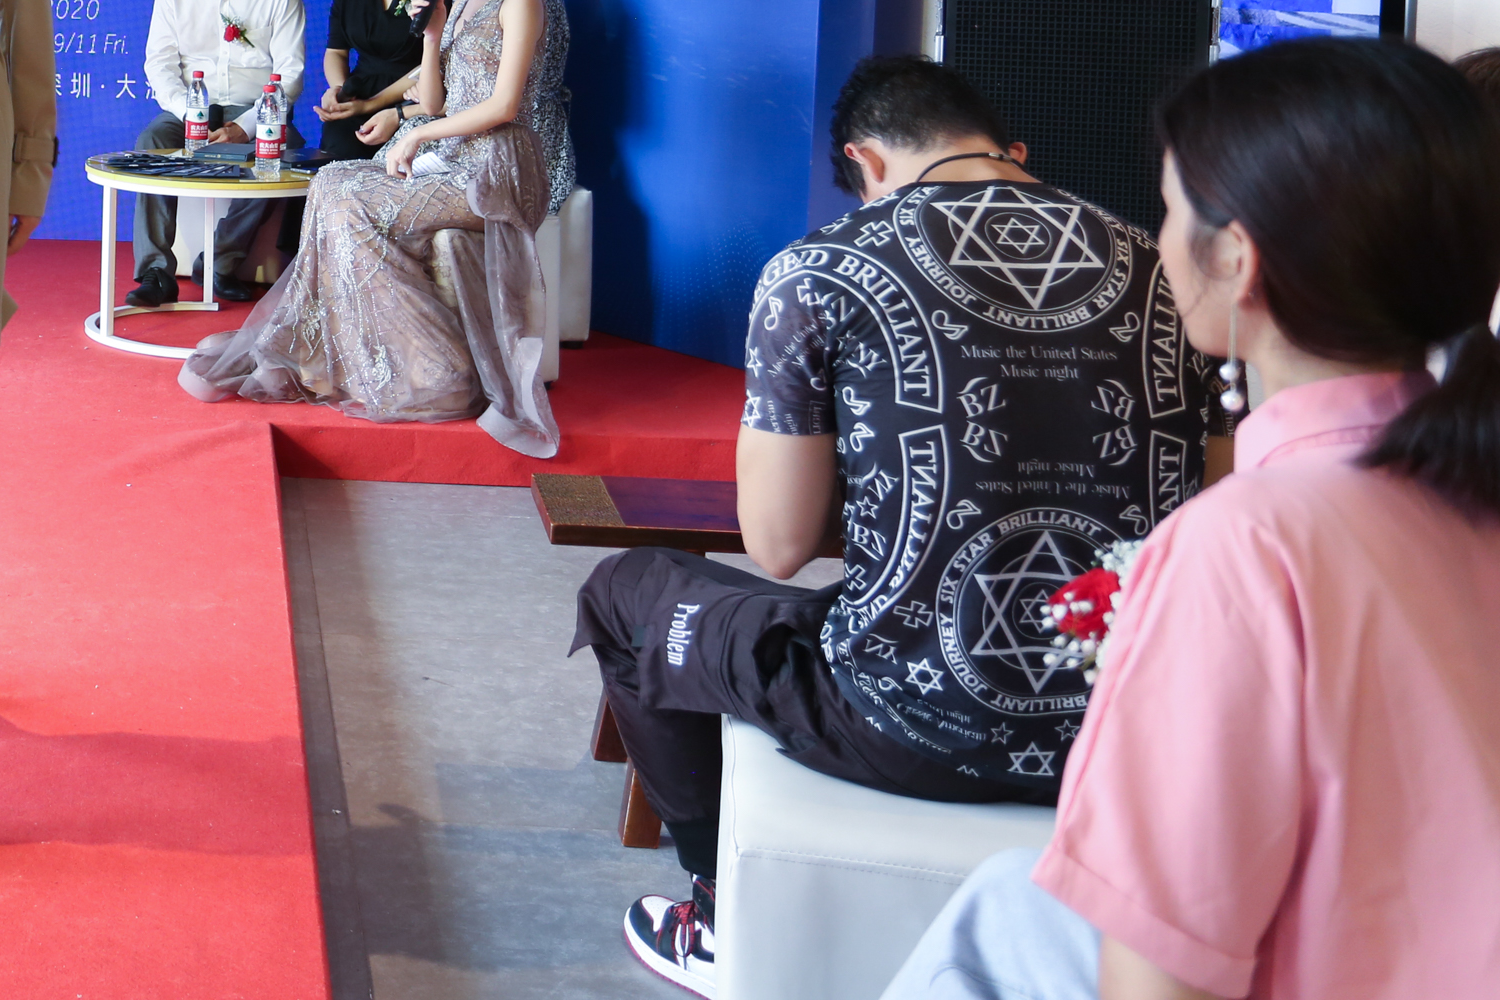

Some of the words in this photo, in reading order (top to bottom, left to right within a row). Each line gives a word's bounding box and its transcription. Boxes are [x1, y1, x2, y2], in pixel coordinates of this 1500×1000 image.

[102, 33, 129, 54] Fri.
[899, 206, 915, 226] SIX
[904, 235, 978, 306] JOURNEY
[1091, 267, 1128, 309] STAR
[752, 248, 830, 304] EGEND
[833, 253, 933, 399] BRILLIANT
[981, 304, 1093, 330] BRILLIANT
[960, 344, 1001, 359] Music
[1006, 345, 1027, 359] the
[1030, 345, 1076, 360] United
[1080, 347, 1117, 361] States
[1000, 364, 1040, 378] Music
[1044, 364, 1079, 381] night
[940, 576, 959, 604] SIX
[952, 531, 995, 573] STAR
[996, 510, 1102, 537] BRILLIANT
[666, 602, 701, 667] Problem
[938, 612, 989, 694] JOURNEY
[990, 693, 1088, 712] BRILLIANT
